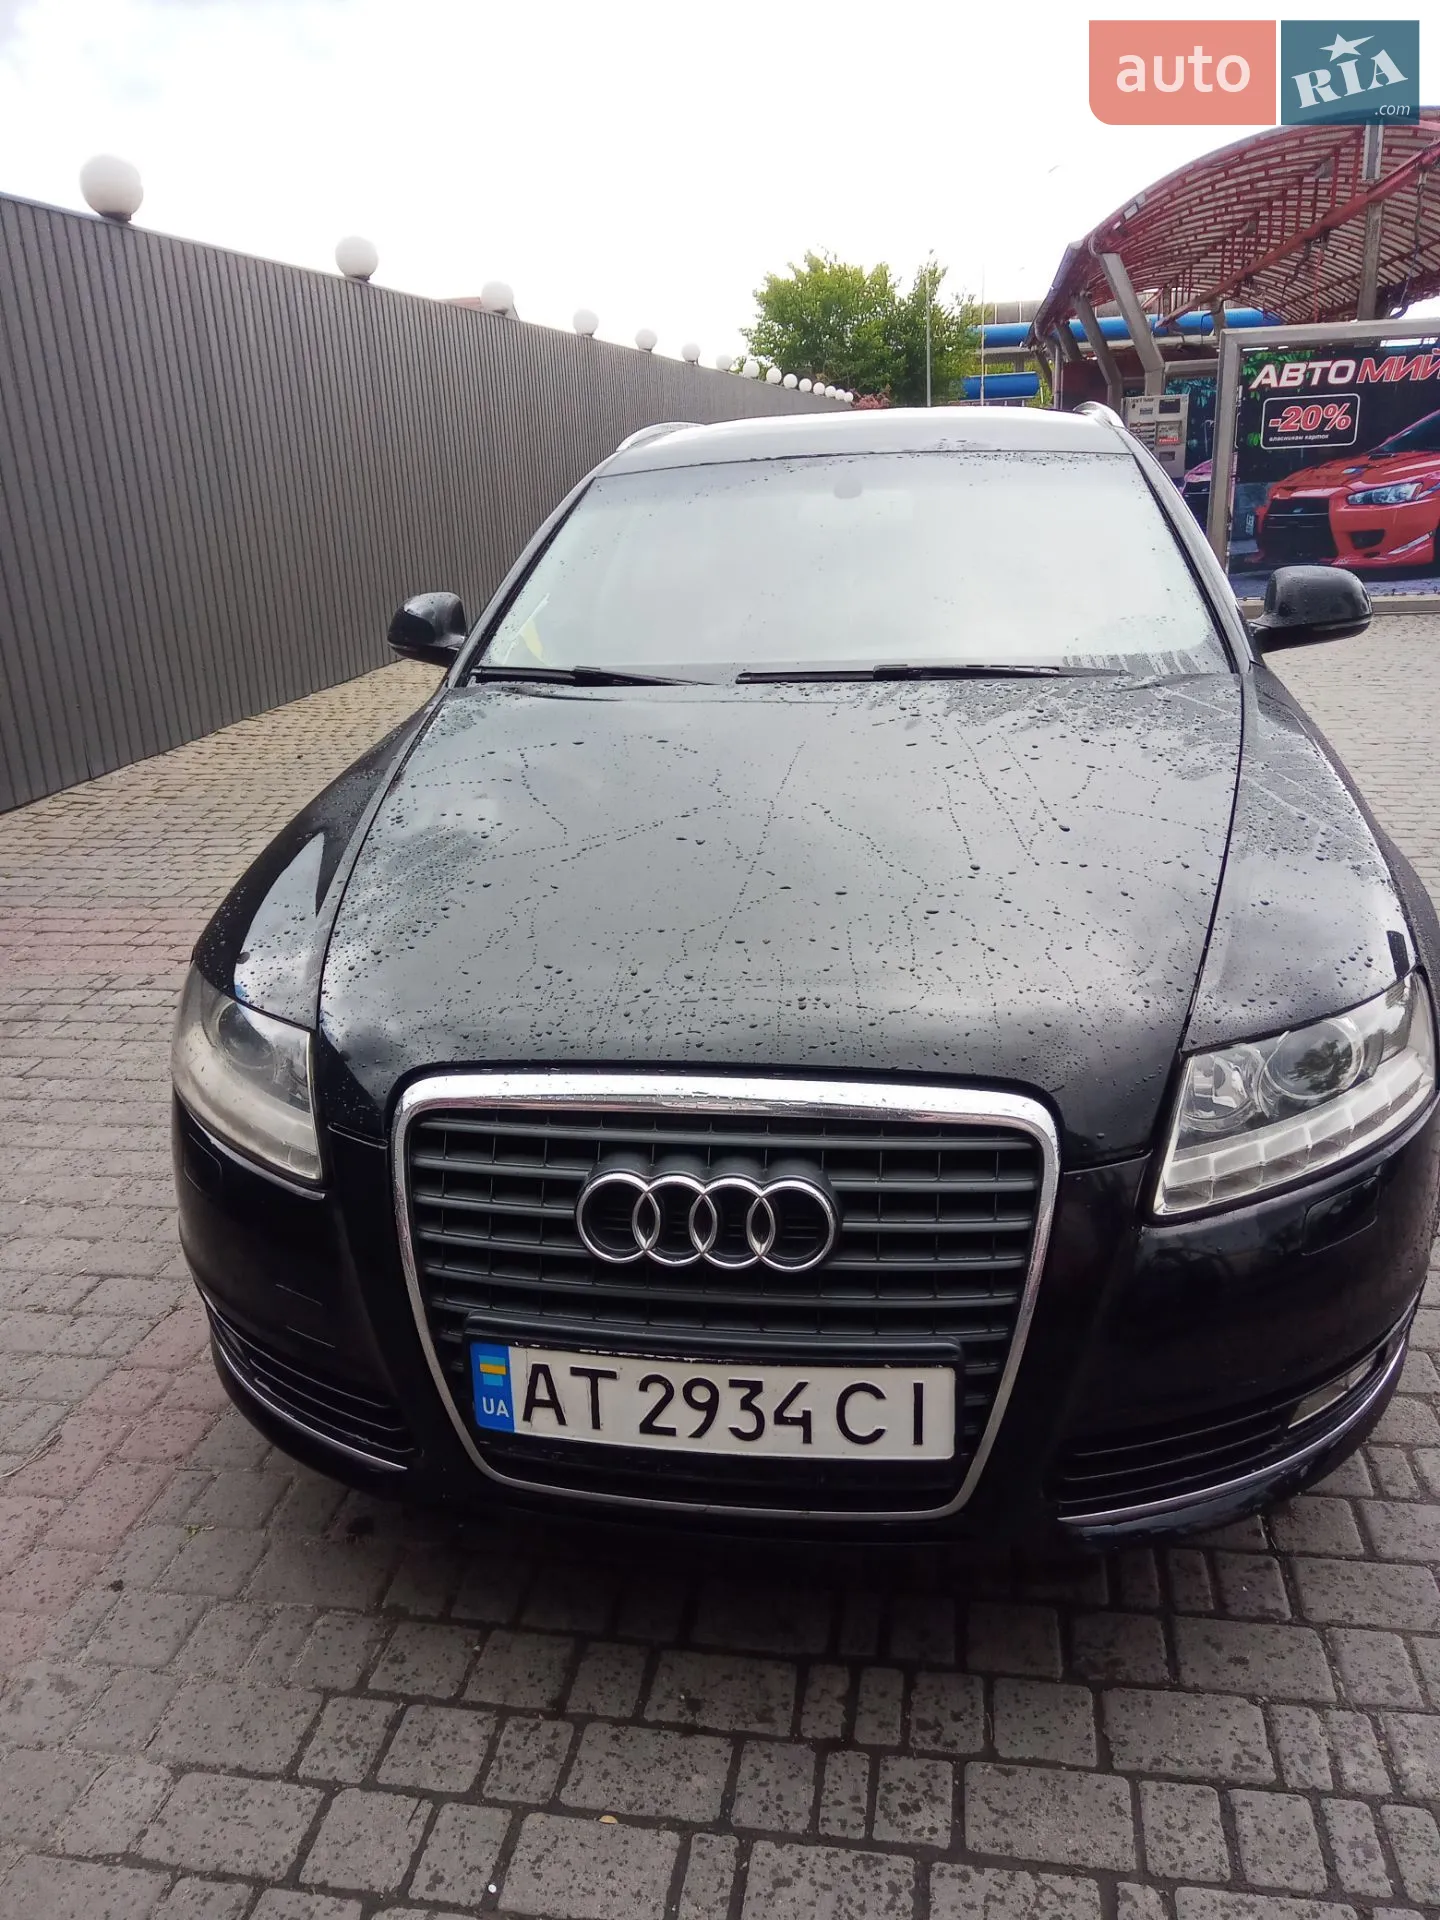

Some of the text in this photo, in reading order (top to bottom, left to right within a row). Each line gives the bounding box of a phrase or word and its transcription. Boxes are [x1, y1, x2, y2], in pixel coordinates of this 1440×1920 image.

[1268, 402, 1352, 432] -20%
[481, 1395, 511, 1419] UA
[522, 1362, 924, 1447] AT 2934 CI
